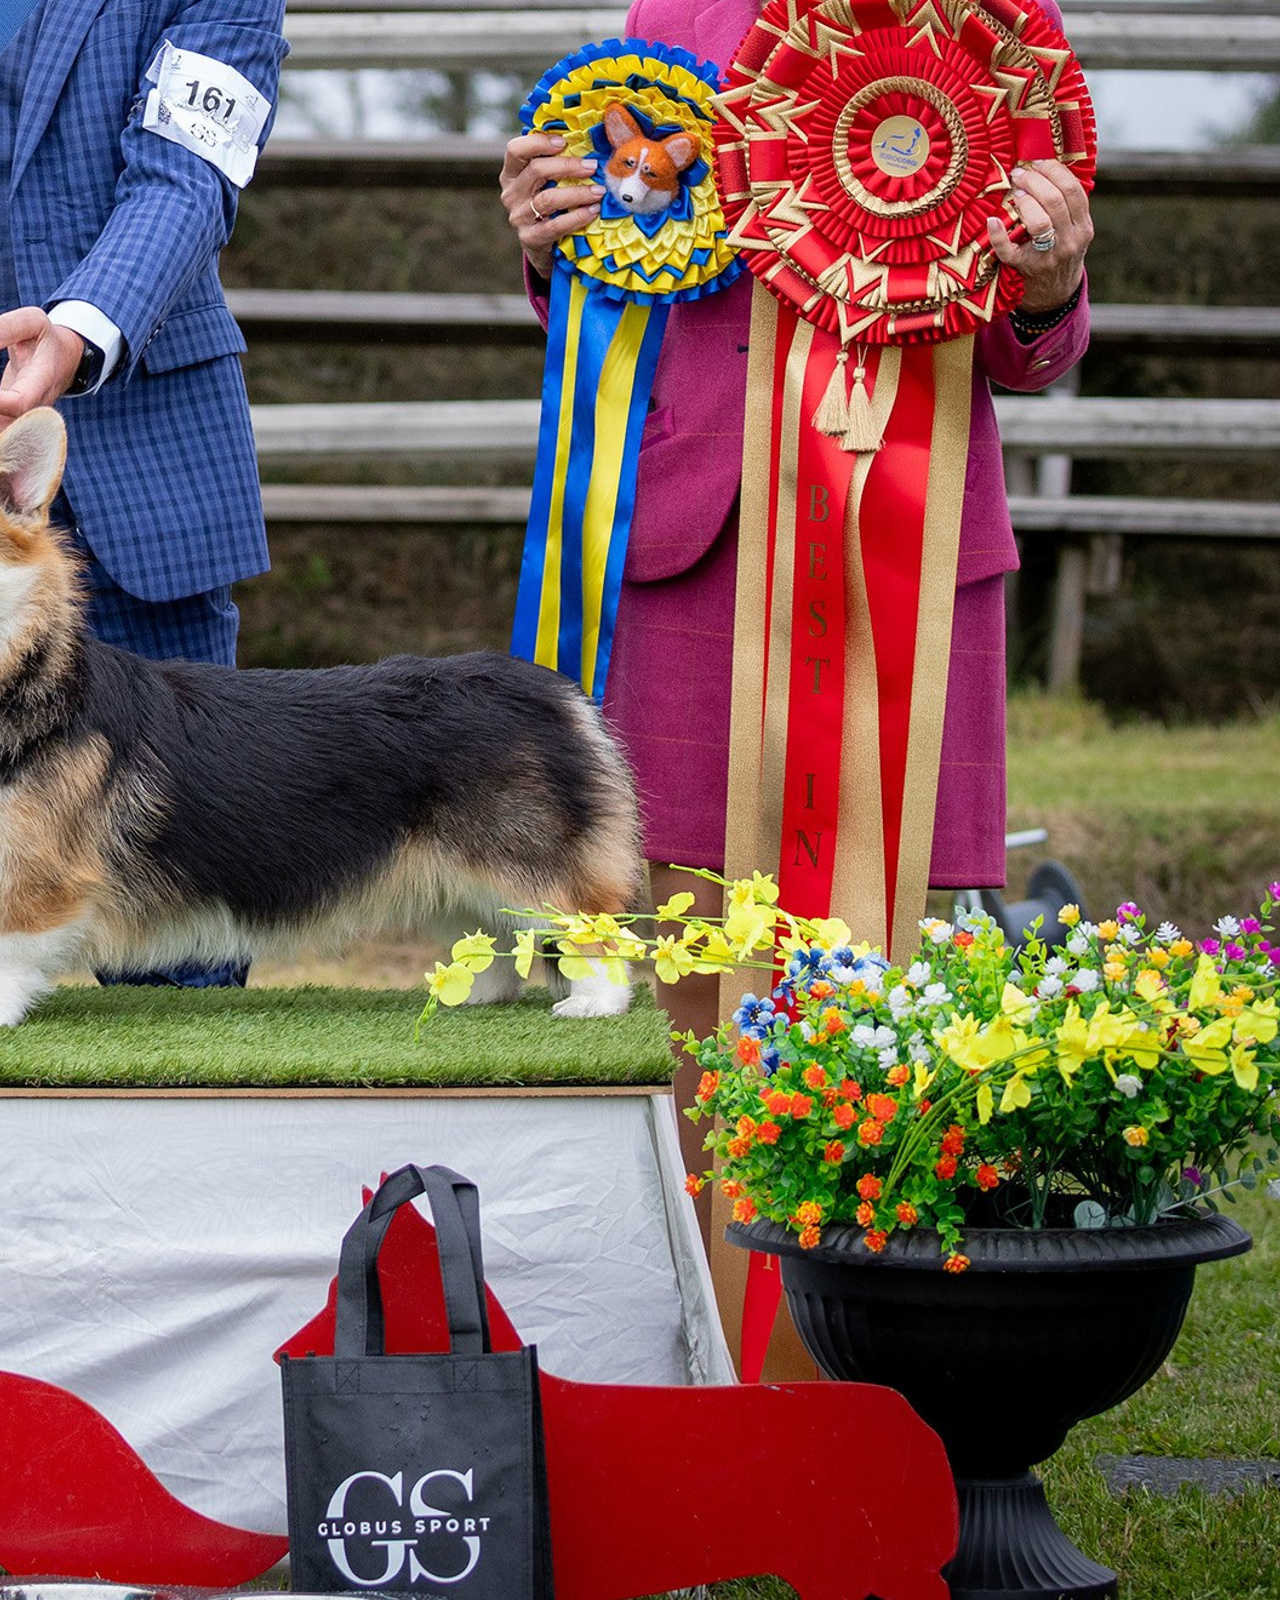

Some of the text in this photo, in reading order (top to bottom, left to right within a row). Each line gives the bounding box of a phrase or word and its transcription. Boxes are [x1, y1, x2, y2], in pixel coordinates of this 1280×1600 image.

[186, 80, 236, 123] 161
[793, 485, 830, 869] BEST IN
[317, 1517, 491, 1537] GLOBUS SPORT
[325, 1468, 481, 1586] GS
